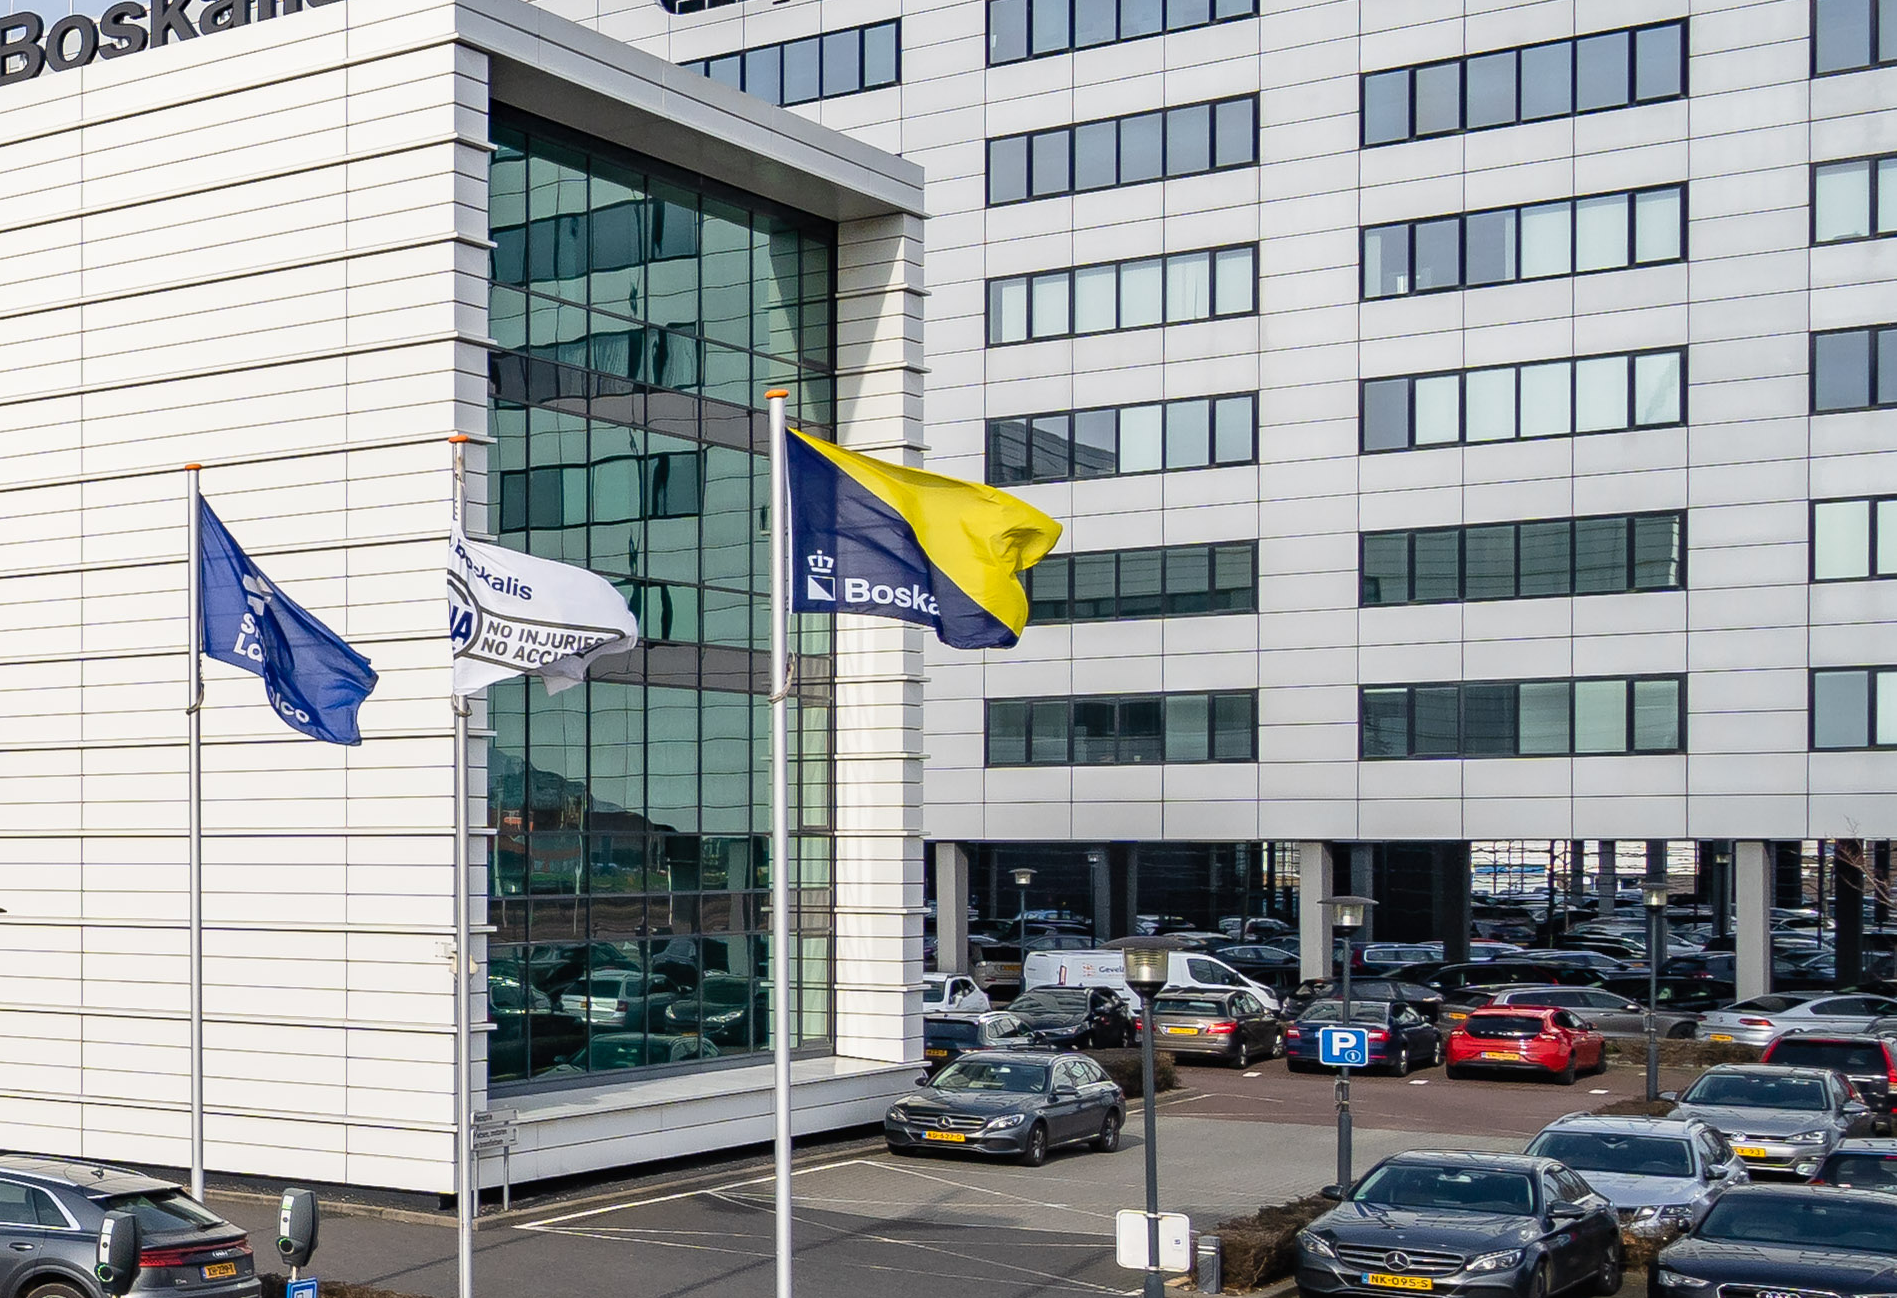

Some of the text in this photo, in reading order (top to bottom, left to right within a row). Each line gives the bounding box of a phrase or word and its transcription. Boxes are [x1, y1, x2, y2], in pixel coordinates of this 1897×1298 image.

[486, 618, 513, 639] NO
[480, 637, 508, 657] NO
[1332, 1031, 1357, 1056] P
[1371, 1274, 1429, 1288] NK-095-S
